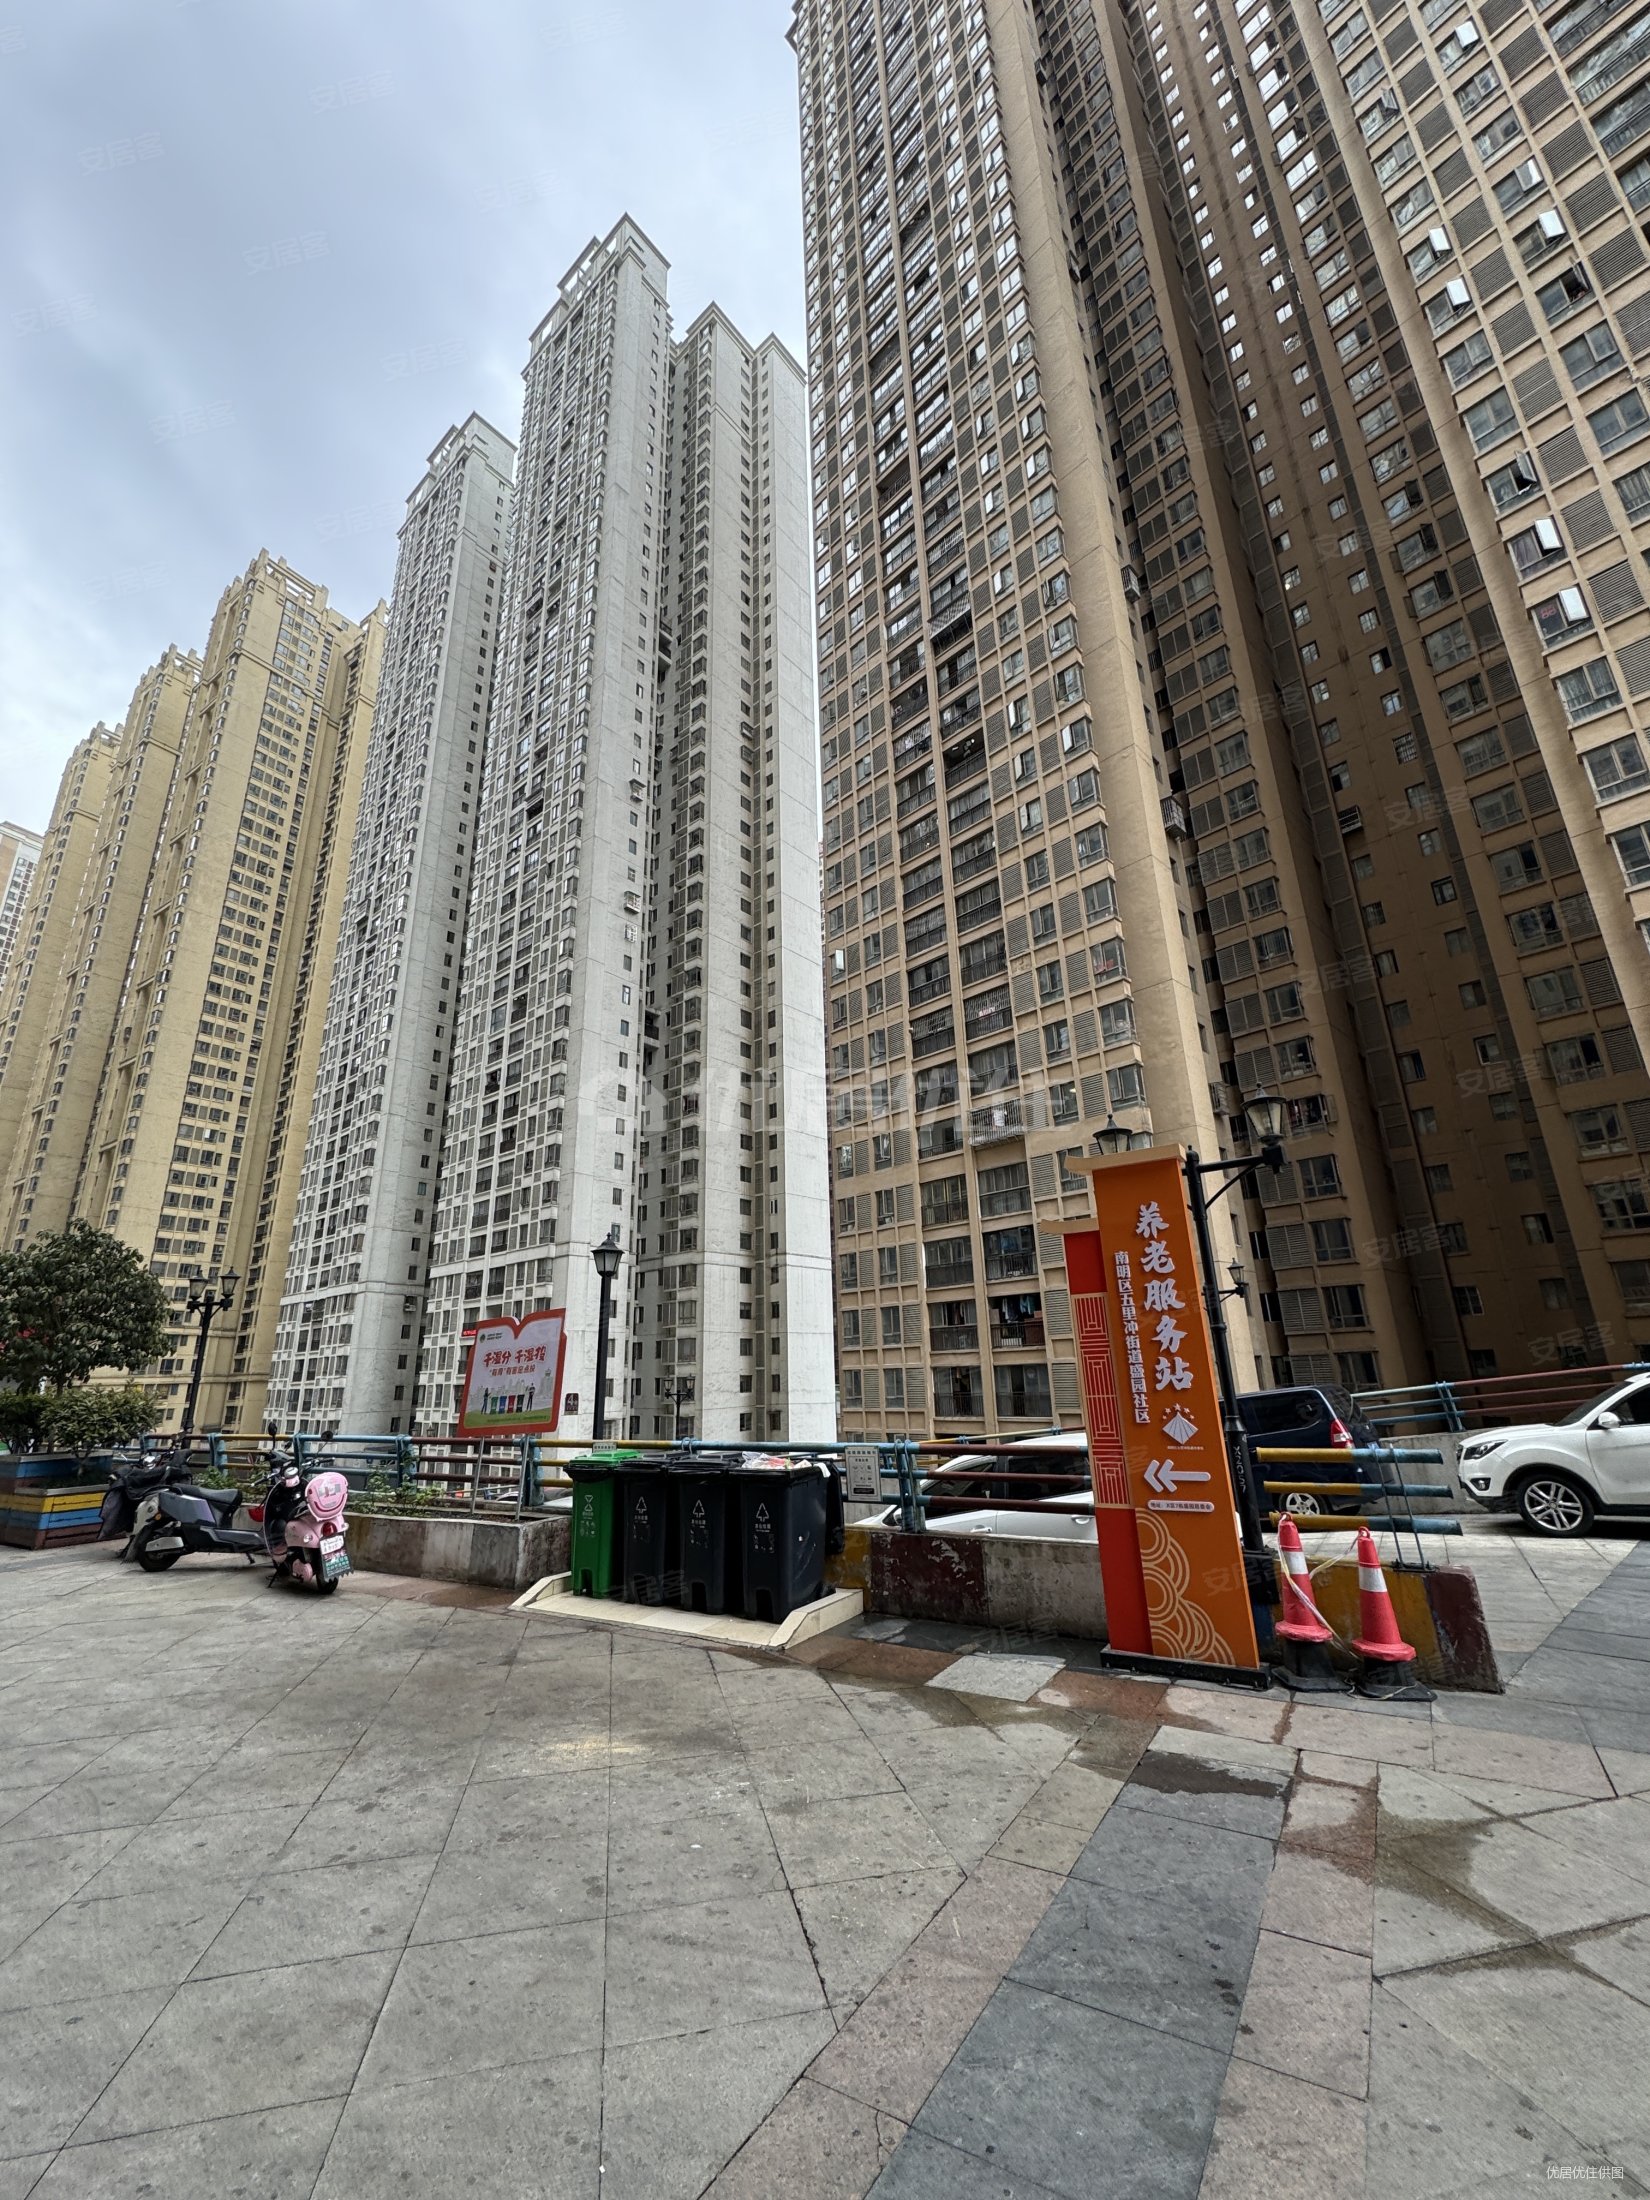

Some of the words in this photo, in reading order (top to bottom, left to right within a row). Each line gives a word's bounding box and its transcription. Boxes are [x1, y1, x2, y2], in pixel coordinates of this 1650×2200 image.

[1114, 1250, 1150, 1425] 南明区五里冲街道盛园社区
[1135, 1201, 1194, 1391] 养老服务站
